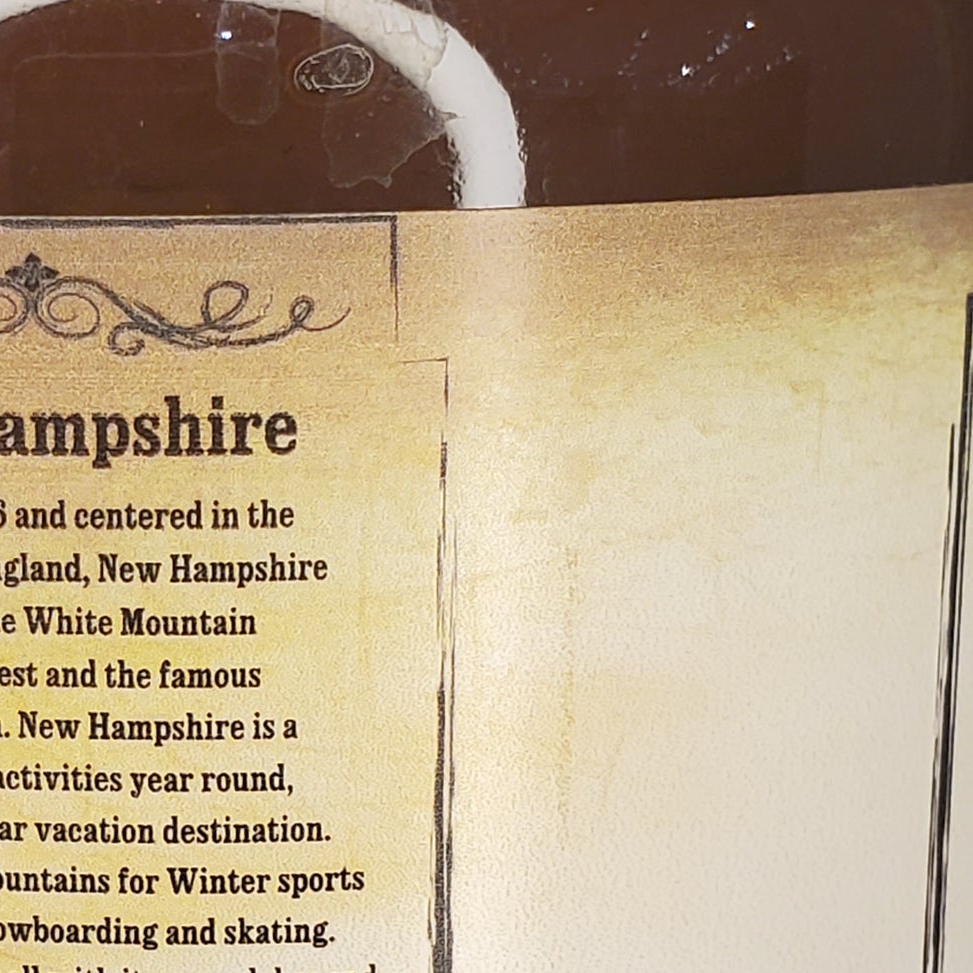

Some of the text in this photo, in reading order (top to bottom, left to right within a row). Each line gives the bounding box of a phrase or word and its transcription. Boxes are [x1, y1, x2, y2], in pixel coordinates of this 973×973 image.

[74, 500, 203, 530] centered
[247, 499, 294, 528] the
[98, 553, 162, 583] New
[170, 552, 328, 588] Hampshire
[23, 606, 112, 636] White
[120, 607, 257, 636] Mountain
[105, 659, 151, 689] the
[159, 660, 261, 688] famous
[18, 710, 81, 739] New
[88, 712, 244, 747] Hampshire
[130, 772, 194, 798] year
[201, 763, 293, 796] round,
[34, 816, 155, 844] vacation
[163, 815, 331, 844] destination.
[118, 867, 159, 894] for
[166, 867, 271, 894] Winter
[278, 867, 364, 899] sports
[224, 917, 335, 948] skating.
